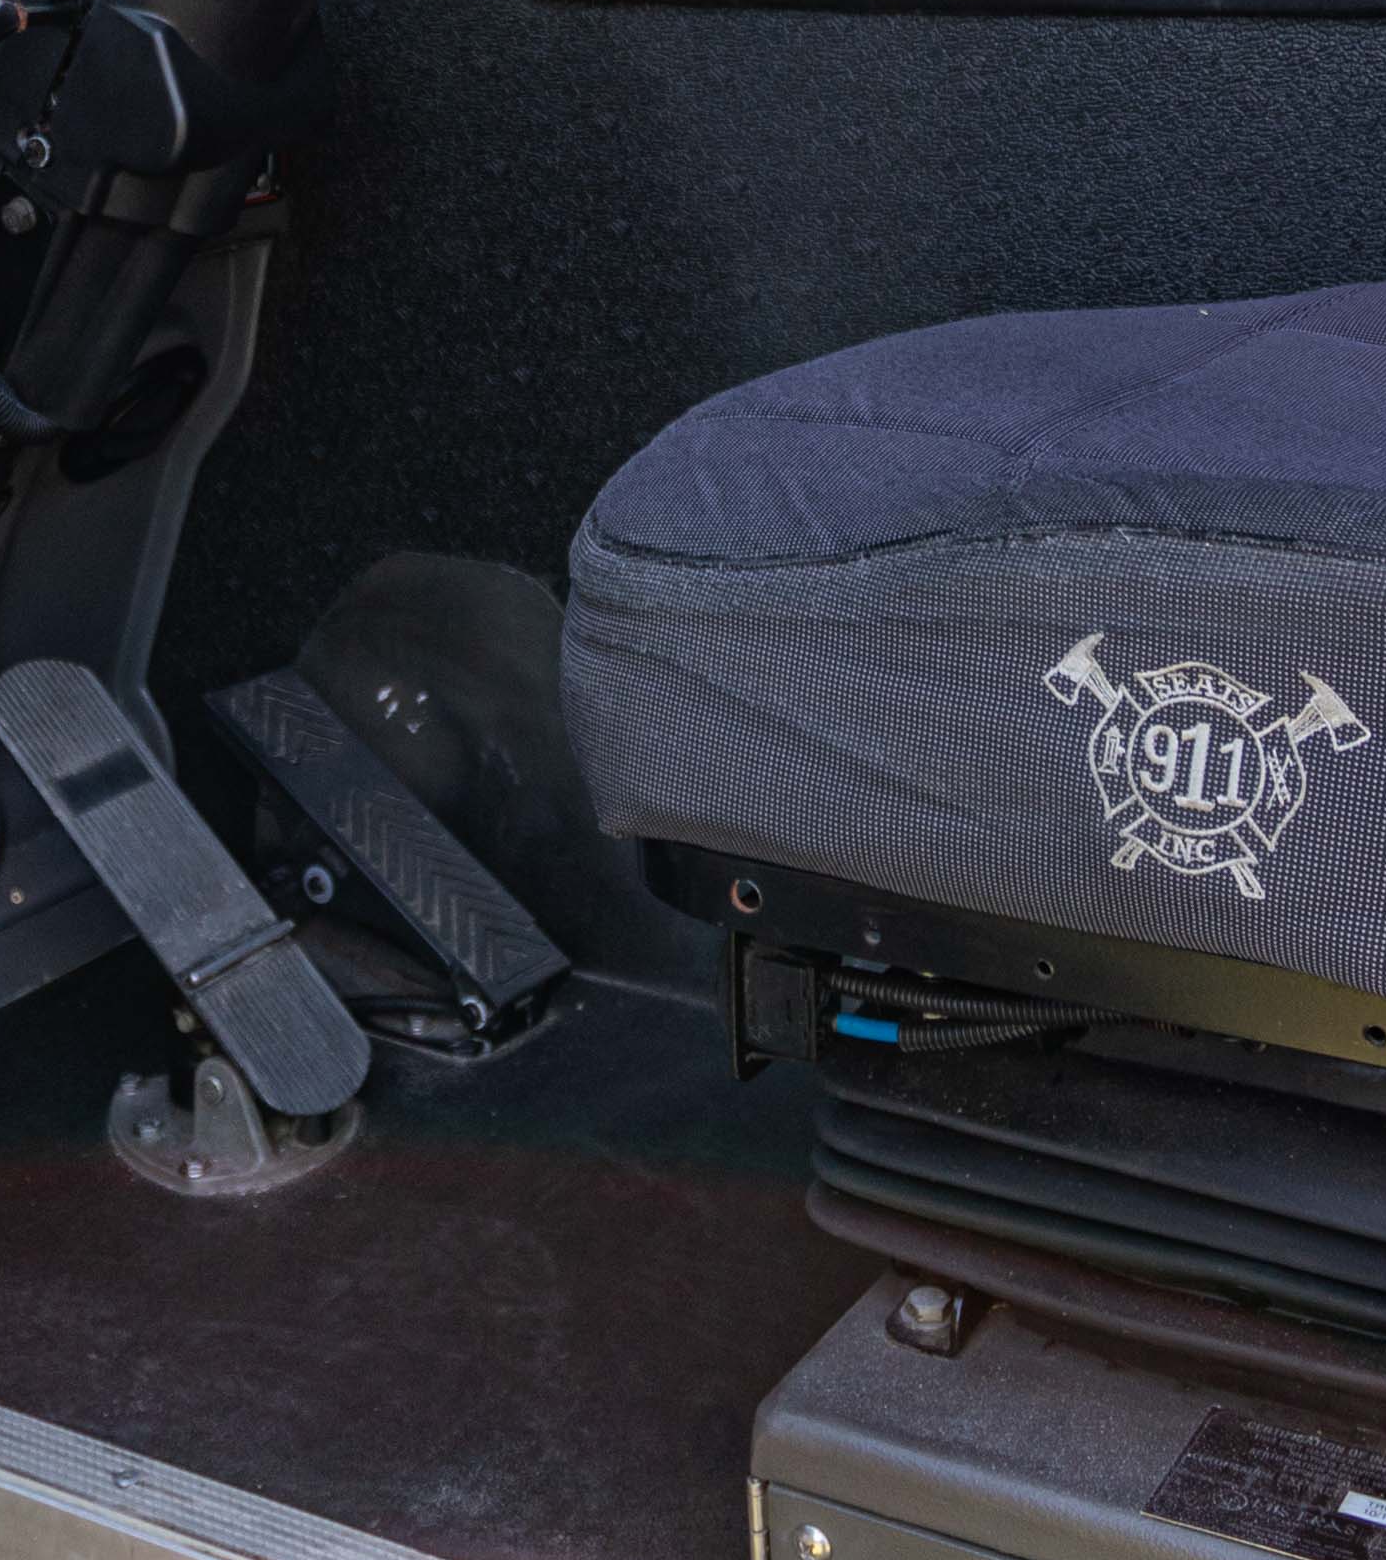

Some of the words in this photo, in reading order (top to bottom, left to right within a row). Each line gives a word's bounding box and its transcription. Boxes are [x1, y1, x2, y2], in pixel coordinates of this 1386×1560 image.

[1152, 674, 1256, 713] SEATS
[1139, 722, 1248, 812] 911
[1156, 834, 1218, 864] INC
